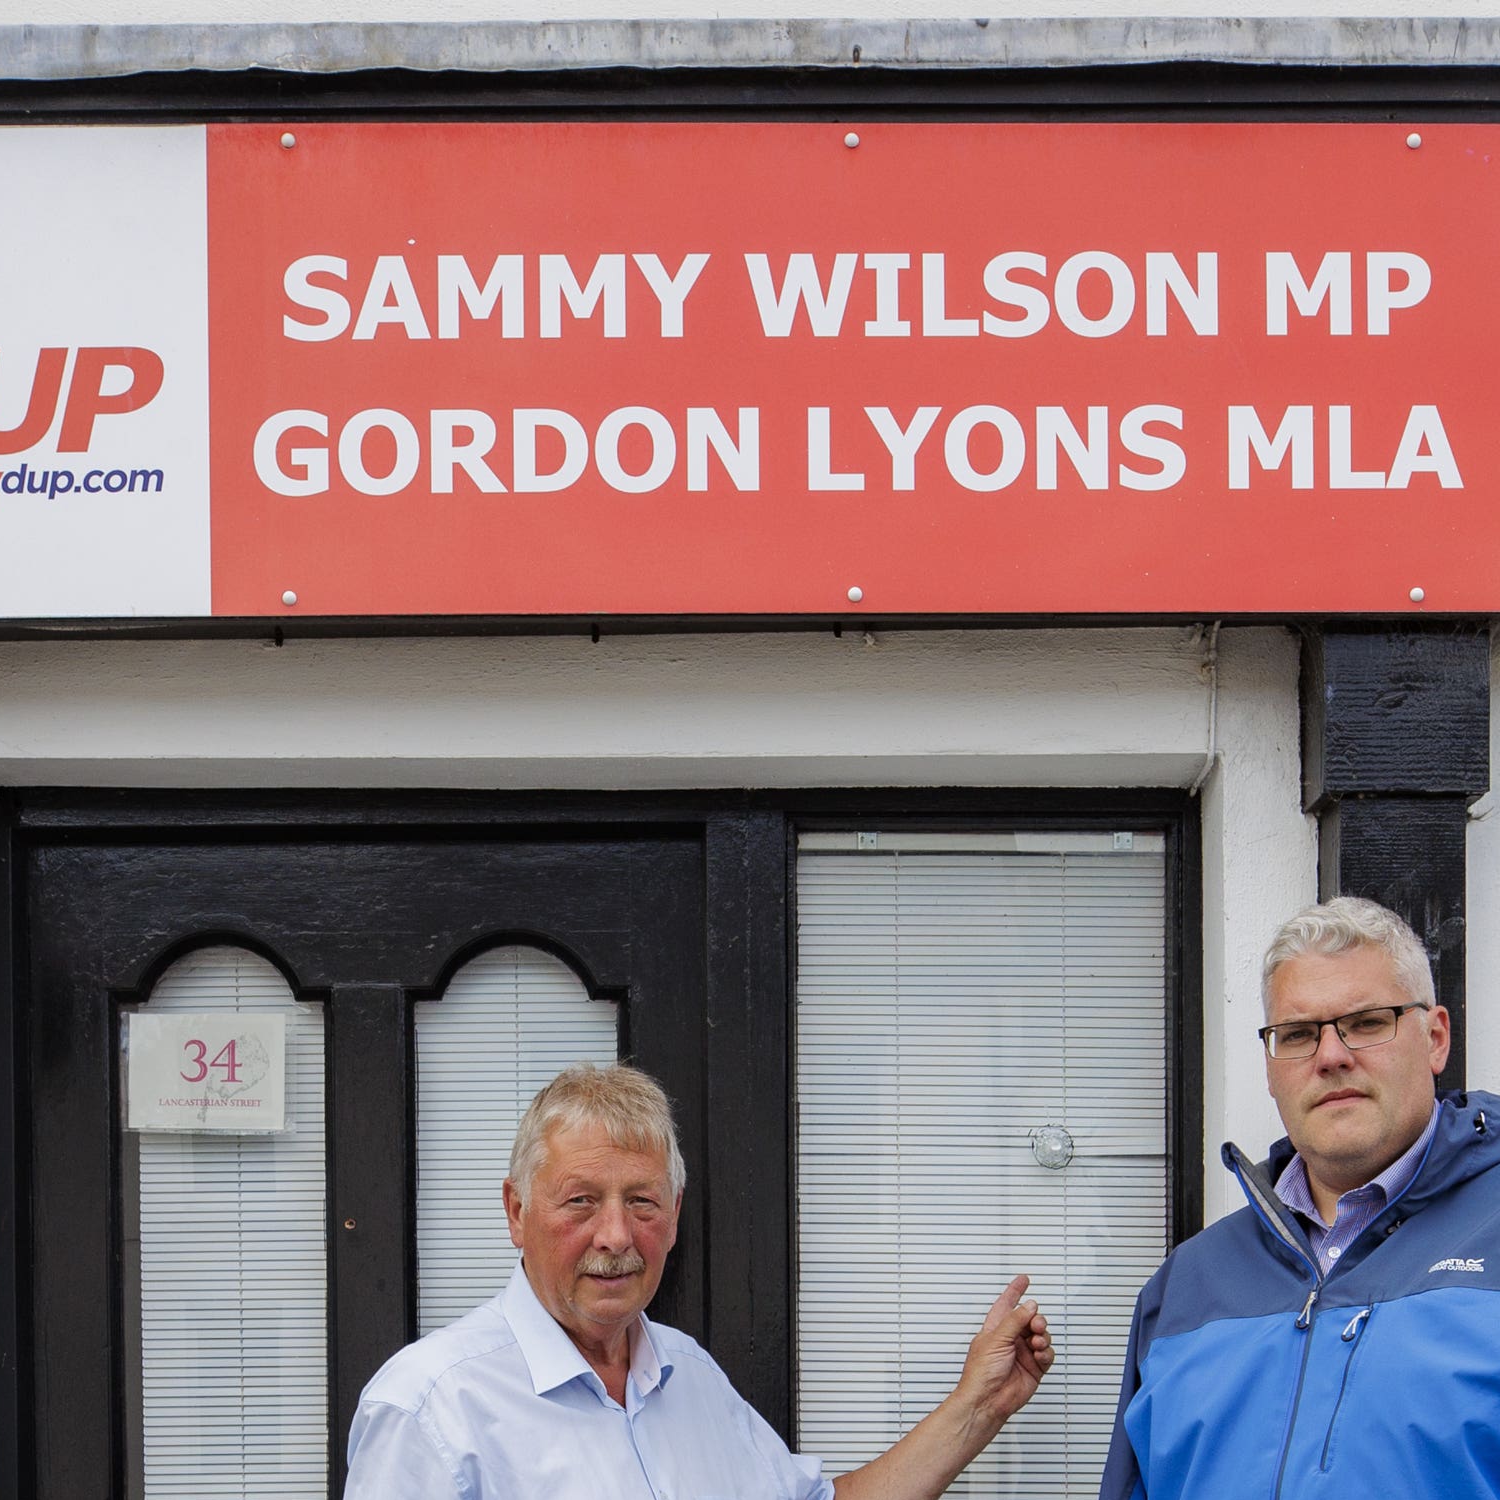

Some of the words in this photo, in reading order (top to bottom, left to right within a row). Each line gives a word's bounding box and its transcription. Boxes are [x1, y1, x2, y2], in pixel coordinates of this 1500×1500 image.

[282, 253, 711, 342] SAMMY
[746, 251, 1219, 339] WILSON
[1265, 252, 1432, 336] MP
[253, 406, 760, 497] GORDON
[807, 405, 1188, 492] LYONS
[1228, 405, 1464, 490] MLA
[180, 1039, 243, 1083] 34
[159, 1098, 228, 1108] LANCASTERIAN
[229, 1098, 262, 1108] STREET
